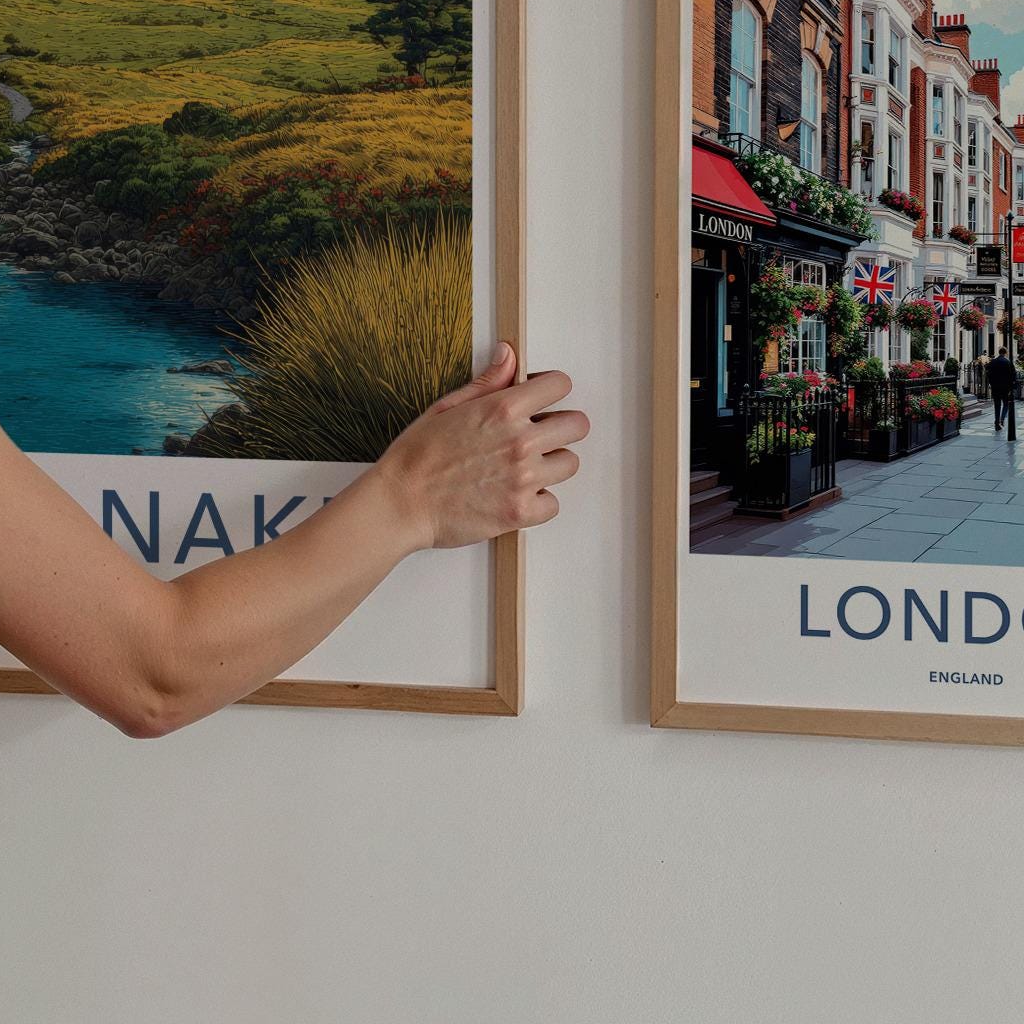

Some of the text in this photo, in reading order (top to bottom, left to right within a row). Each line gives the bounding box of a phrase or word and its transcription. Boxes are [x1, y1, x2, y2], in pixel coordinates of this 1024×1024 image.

[698, 213, 753, 242] LONDON
[102, 489, 334, 564] NAK
[800, 584, 1024, 645] LOND
[929, 671, 1004, 686] ENGLAND
